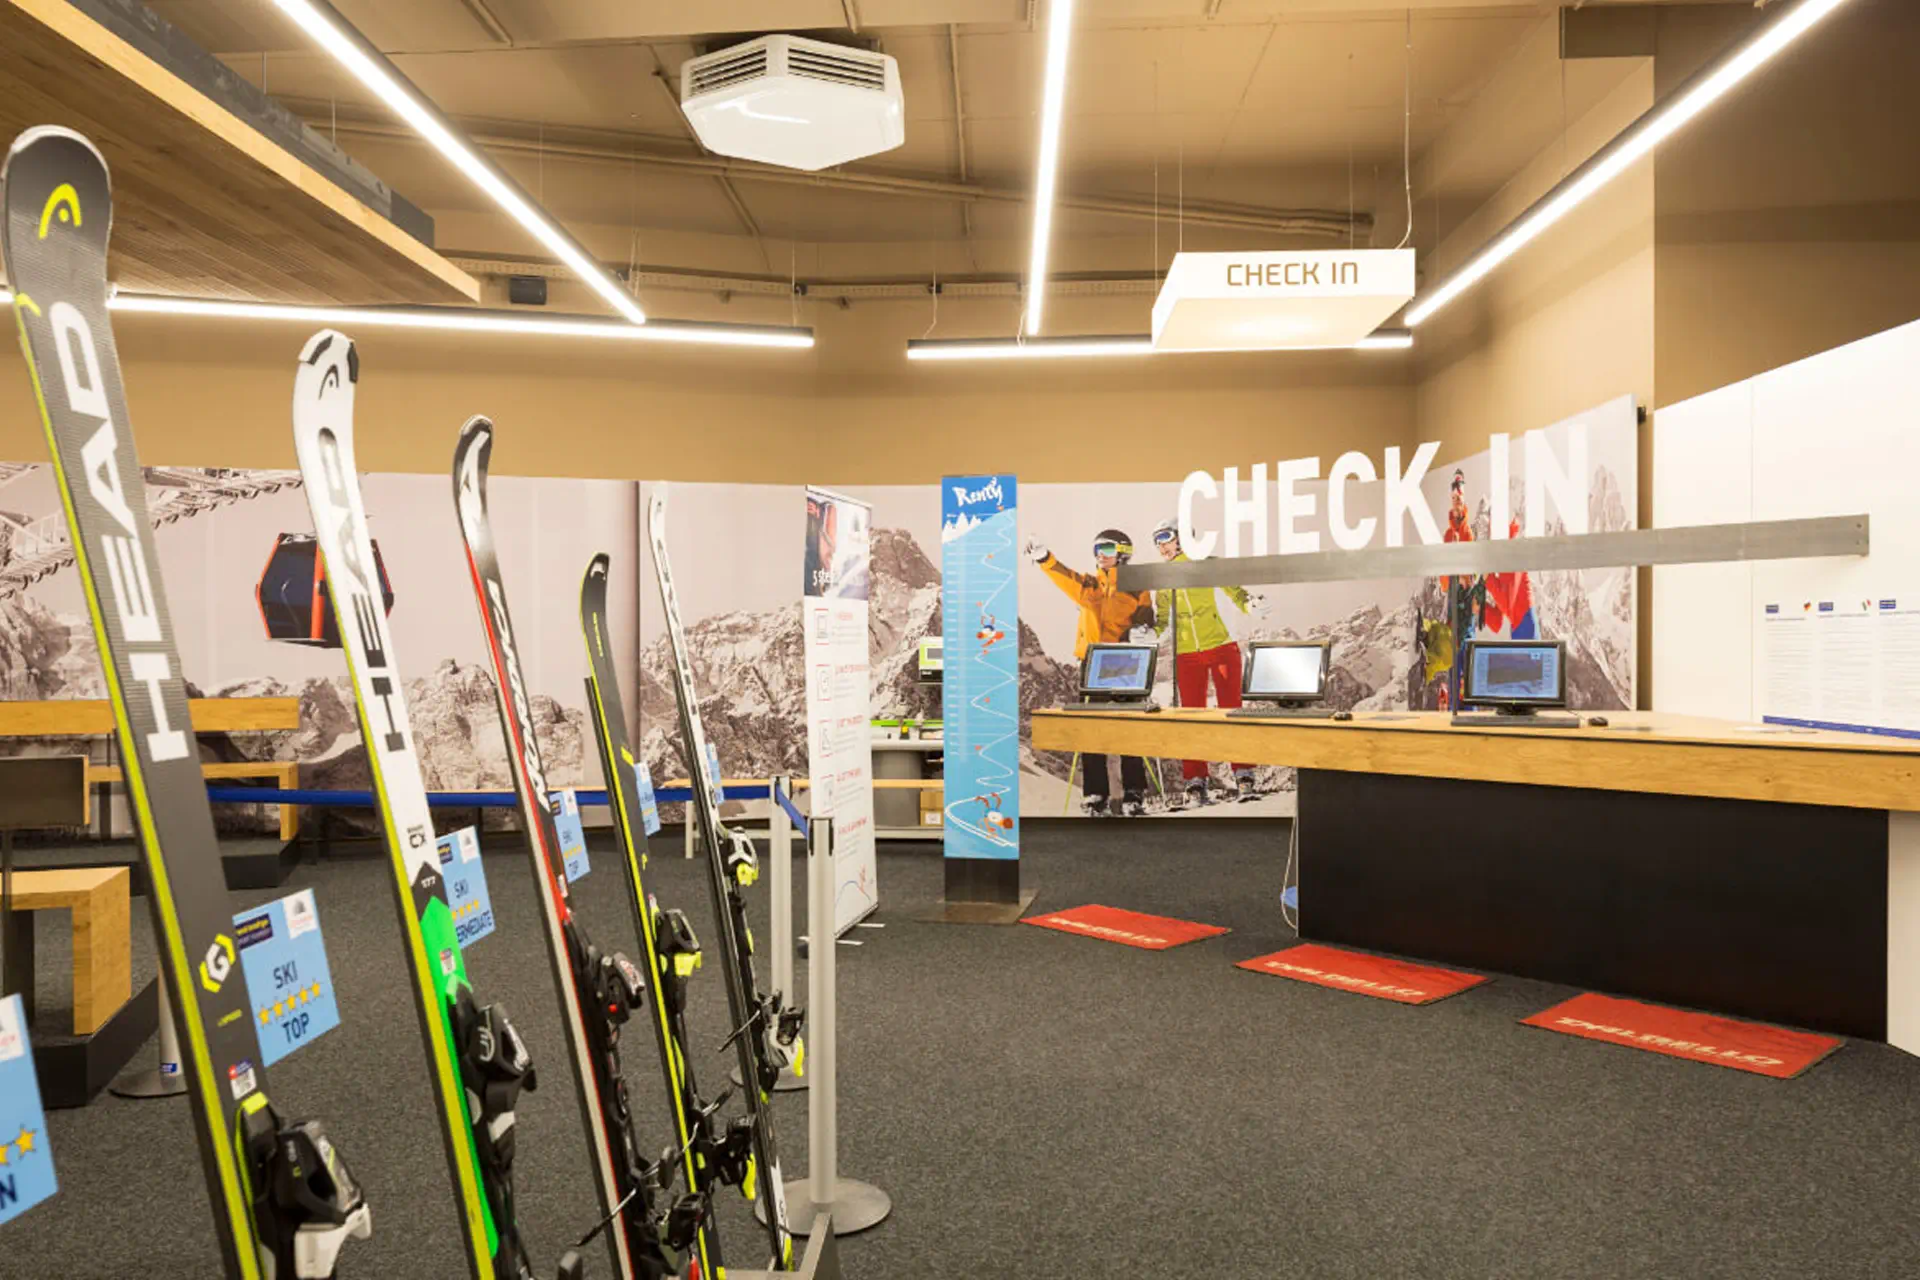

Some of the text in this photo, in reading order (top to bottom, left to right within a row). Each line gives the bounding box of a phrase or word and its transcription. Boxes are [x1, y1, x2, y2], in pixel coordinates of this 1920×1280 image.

[1227, 262, 1320, 286] CHECK
[1177, 424, 1590, 561] CHECK IN
[48, 300, 190, 763] HEAD
[318, 426, 406, 752] HEAD
[455, 909, 493, 943] ERMEDIATE
[272, 960, 299, 989] SKI
[281, 1012, 310, 1043] TOP
